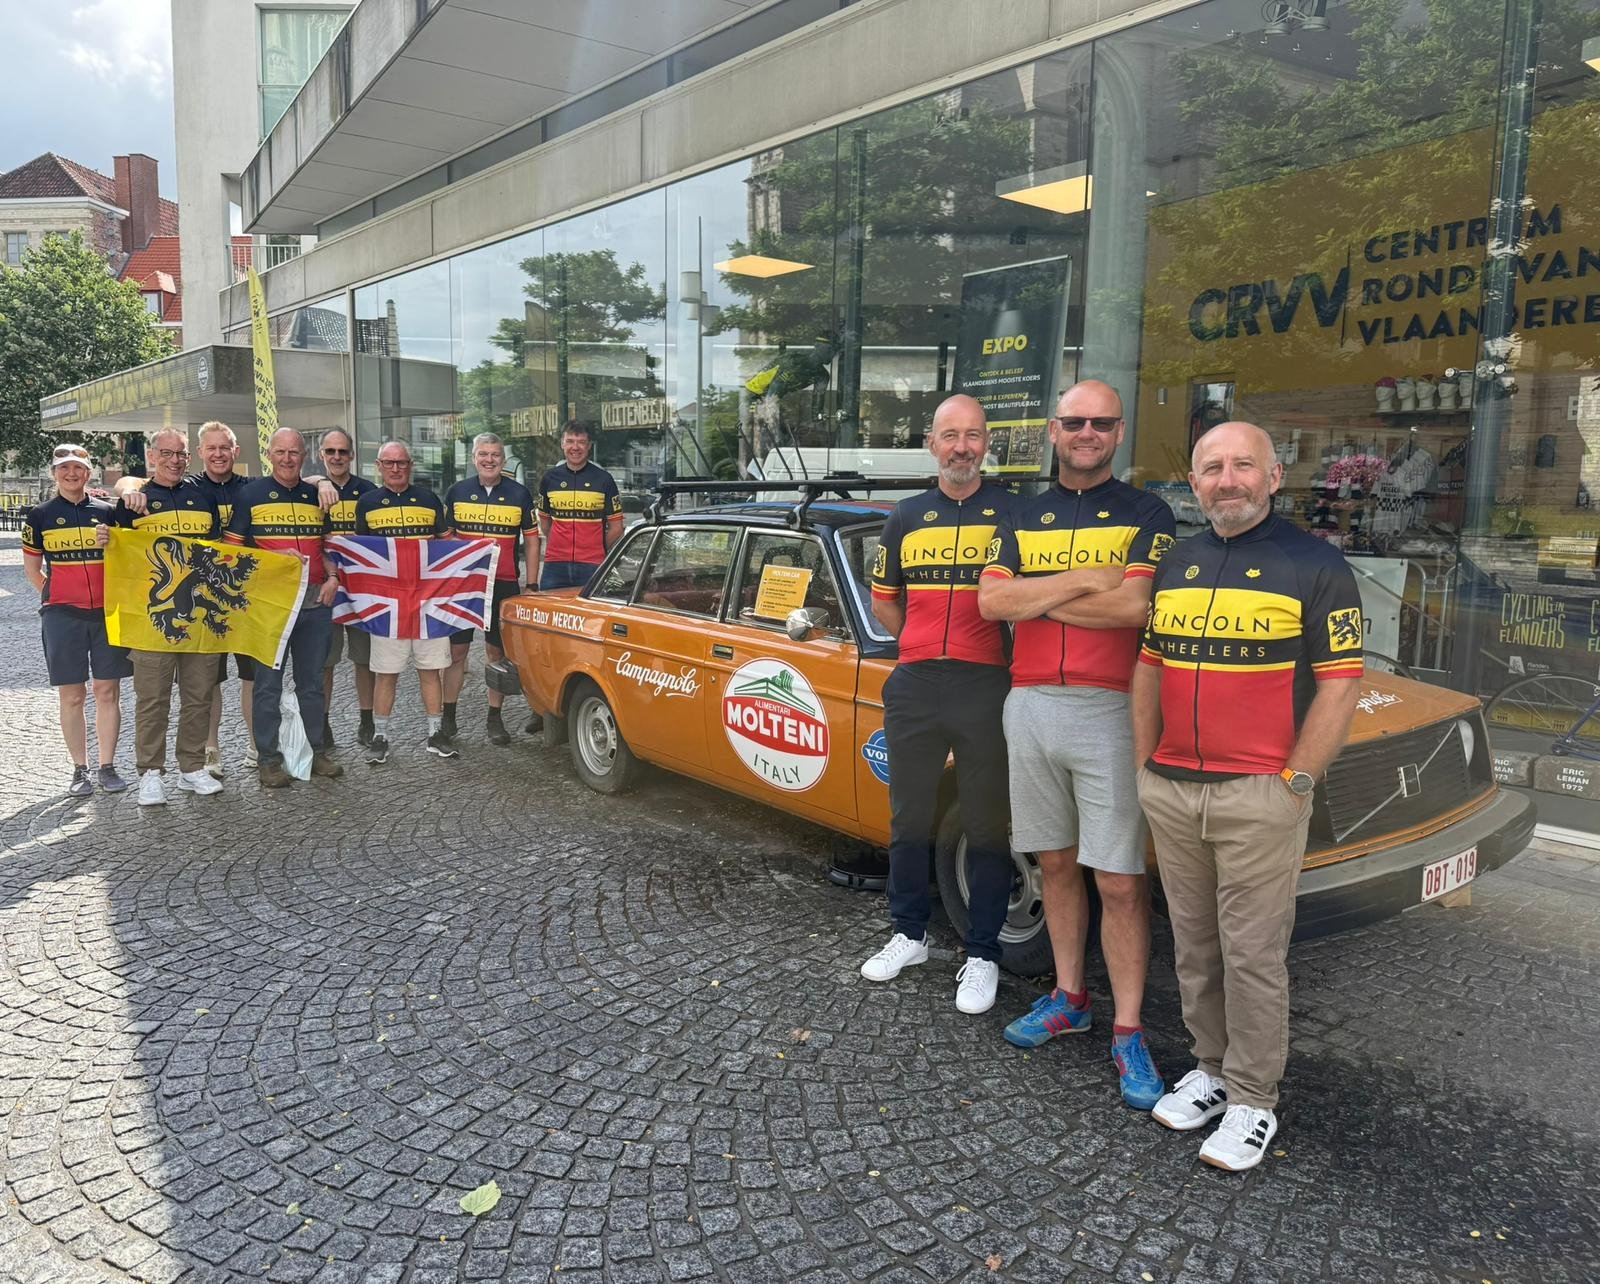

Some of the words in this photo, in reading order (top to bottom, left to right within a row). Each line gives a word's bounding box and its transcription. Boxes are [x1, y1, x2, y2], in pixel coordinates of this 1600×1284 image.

[1364, 203, 1563, 263] CENTRM
[1357, 294, 1600, 346] VLAANERE
[982, 335, 1027, 355] EXPO
[962, 379, 997, 388] VLAANDERENS
[998, 376, 1021, 384] MOOISTE
[552, 500, 598, 508] LINCOLN
[375, 516, 429, 526] LINCOLN
[457, 512, 512, 523] LINCOLN
[461, 524, 509, 533] WHEELERS
[47, 538, 96, 549] LINCO
[53, 551, 99, 560] WHEELE
[903, 546, 990, 562] LINCOL
[1019, 549, 1124, 567] LINCOLN
[905, 569, 980, 580] WHEELE
[552, 611, 585, 632] MERCKX
[1153, 614, 1271, 633] LINCOLN
[1500, 613, 1566, 649] FLANDERS
[1159, 640, 1266, 657] WHEELERS
[608, 651, 701, 698] Campagnolo
[754, 699, 791, 716] ALIMENTARI
[726, 701, 824, 752] MOLTENI
[753, 753, 801, 784] ITALY
[1562, 768, 1585, 776] ERIC
[1556, 774, 1590, 785] LEMAN
[1561, 783, 1584, 792] 1972
